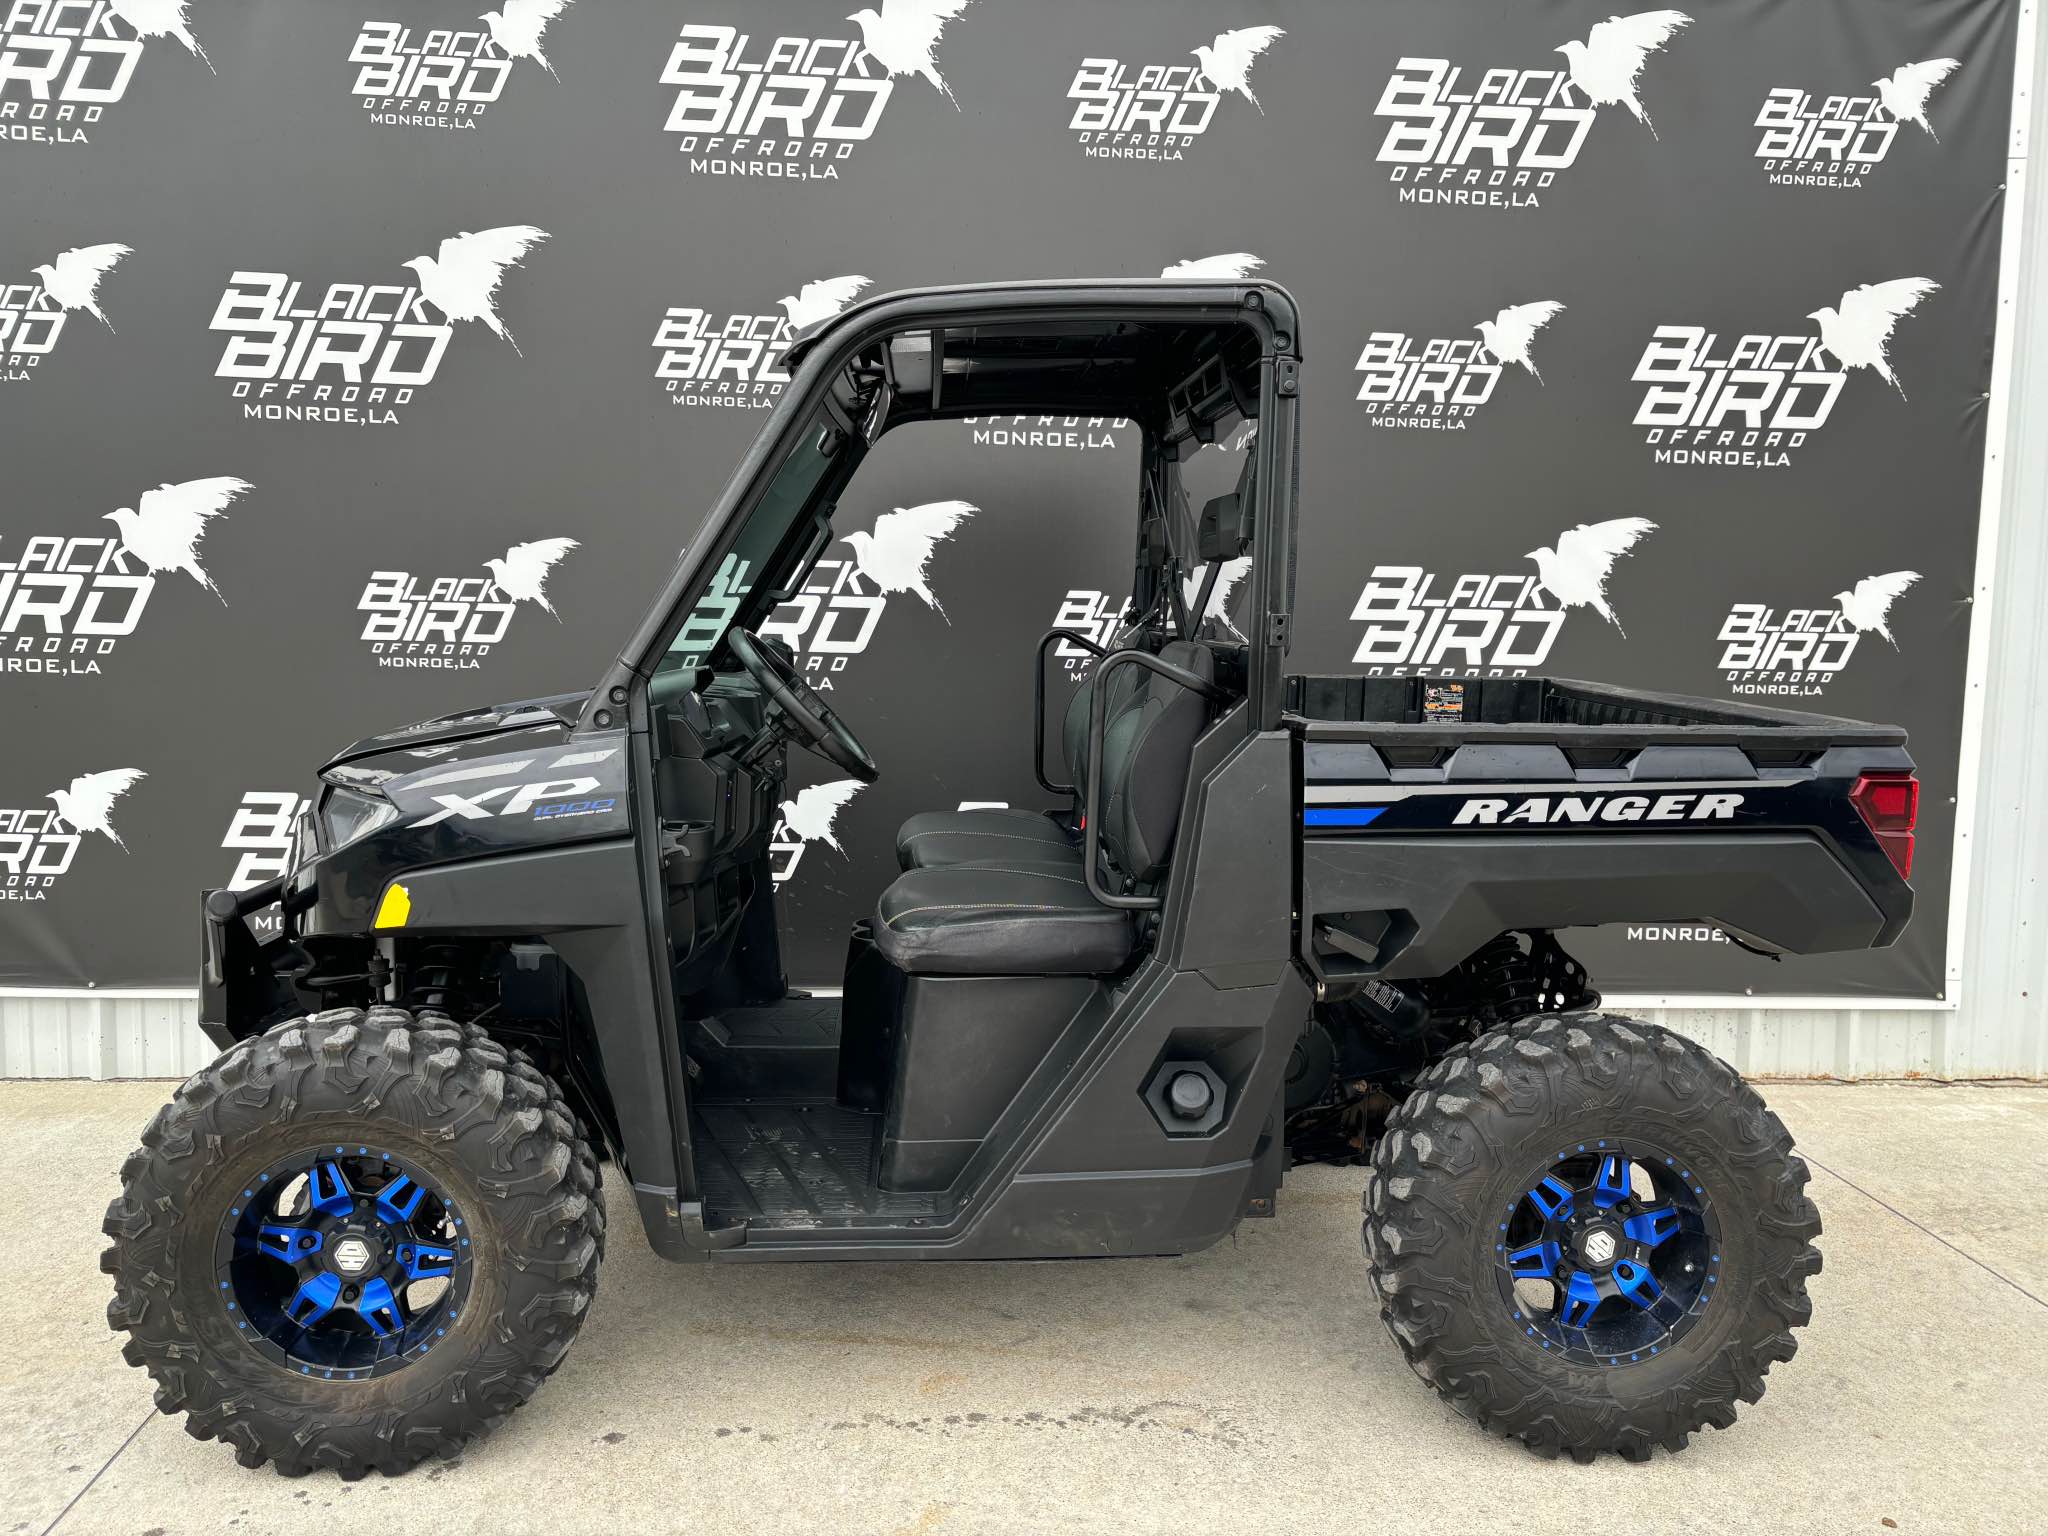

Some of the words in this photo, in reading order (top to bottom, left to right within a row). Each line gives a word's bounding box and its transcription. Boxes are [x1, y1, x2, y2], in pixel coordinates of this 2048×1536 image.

[0, 0, 118, 38] ACK
[348, 21, 496, 62] BLACK
[659, 24, 871, 84] BLACK
[0, 34, 144, 103] RD
[352, 55, 513, 102] BIRD
[1067, 57, 1205, 98] BLACK
[1374, 57, 1574, 115] BLACK
[363, 97, 486, 115] OFFROAD
[370, 112, 476, 130] MONROE,LA
[664, 73, 894, 140] BIRD
[1069, 90, 1221, 134] BIRD
[1754, 87, 1884, 126] BLACK
[680, 136, 854, 159] OFFROAD
[1079, 131, 1194, 147] OFFROAD
[1085, 146, 1183, 162] MONROE,LA
[1376, 105, 1597, 169] BIRD
[1755, 119, 1899, 162] BIRD
[690, 158, 839, 181] MONROE,LA
[1390, 165, 1556, 188] OFFROAD
[1763, 159, 1873, 175] OFFROAD
[1769, 173, 1862, 189] MONROE,LA
[1399, 187, 1540, 210] MONROE,LA
[208, 270, 428, 330] BLACK
[652, 307, 793, 347] BLACK
[214, 319, 453, 385] BIRD
[1355, 331, 1488, 370] BLACK
[1631, 325, 1826, 382] BLACK
[232, 381, 414, 404] OFFROAD
[666, 380, 783, 395] OFFROAD
[1356, 362, 1503, 405] BIRD
[1632, 369, 1848, 429] BIRD
[244, 403, 399, 427] MONROE,LA
[672, 394, 773, 410] MONROE,LA
[1365, 402, 1477, 417] OFFROAD
[973, 429, 1116, 450] MONROE,LA
[1371, 416, 1466, 431] MONROE,LA
[1645, 428, 1807, 448] OFFROAD
[1654, 449, 1791, 469] MONROE,LA
[357, 571, 499, 610] BLACK
[1350, 565, 1545, 620] BLACK
[360, 601, 516, 643] BIRD
[668, 595, 887, 655] BRD
[1352, 608, 1567, 667] BIRD
[1717, 603, 1846, 641] BLACK
[371, 642, 490, 656] OFFROAD
[379, 656, 481, 671] MONROE,LA
[1718, 632, 1860, 671] BIRD
[0, 657, 102, 677] ROE,LA
[1726, 670, 1834, 683] OFFROAD
[1732, 684, 1823, 697] MONROE,LA
[404, 776, 601, 829] XP
[534, 799, 616, 817] 1000
[1452, 793, 1745, 825] RANGER
[1627, 927, 1743, 945] MONROE,
